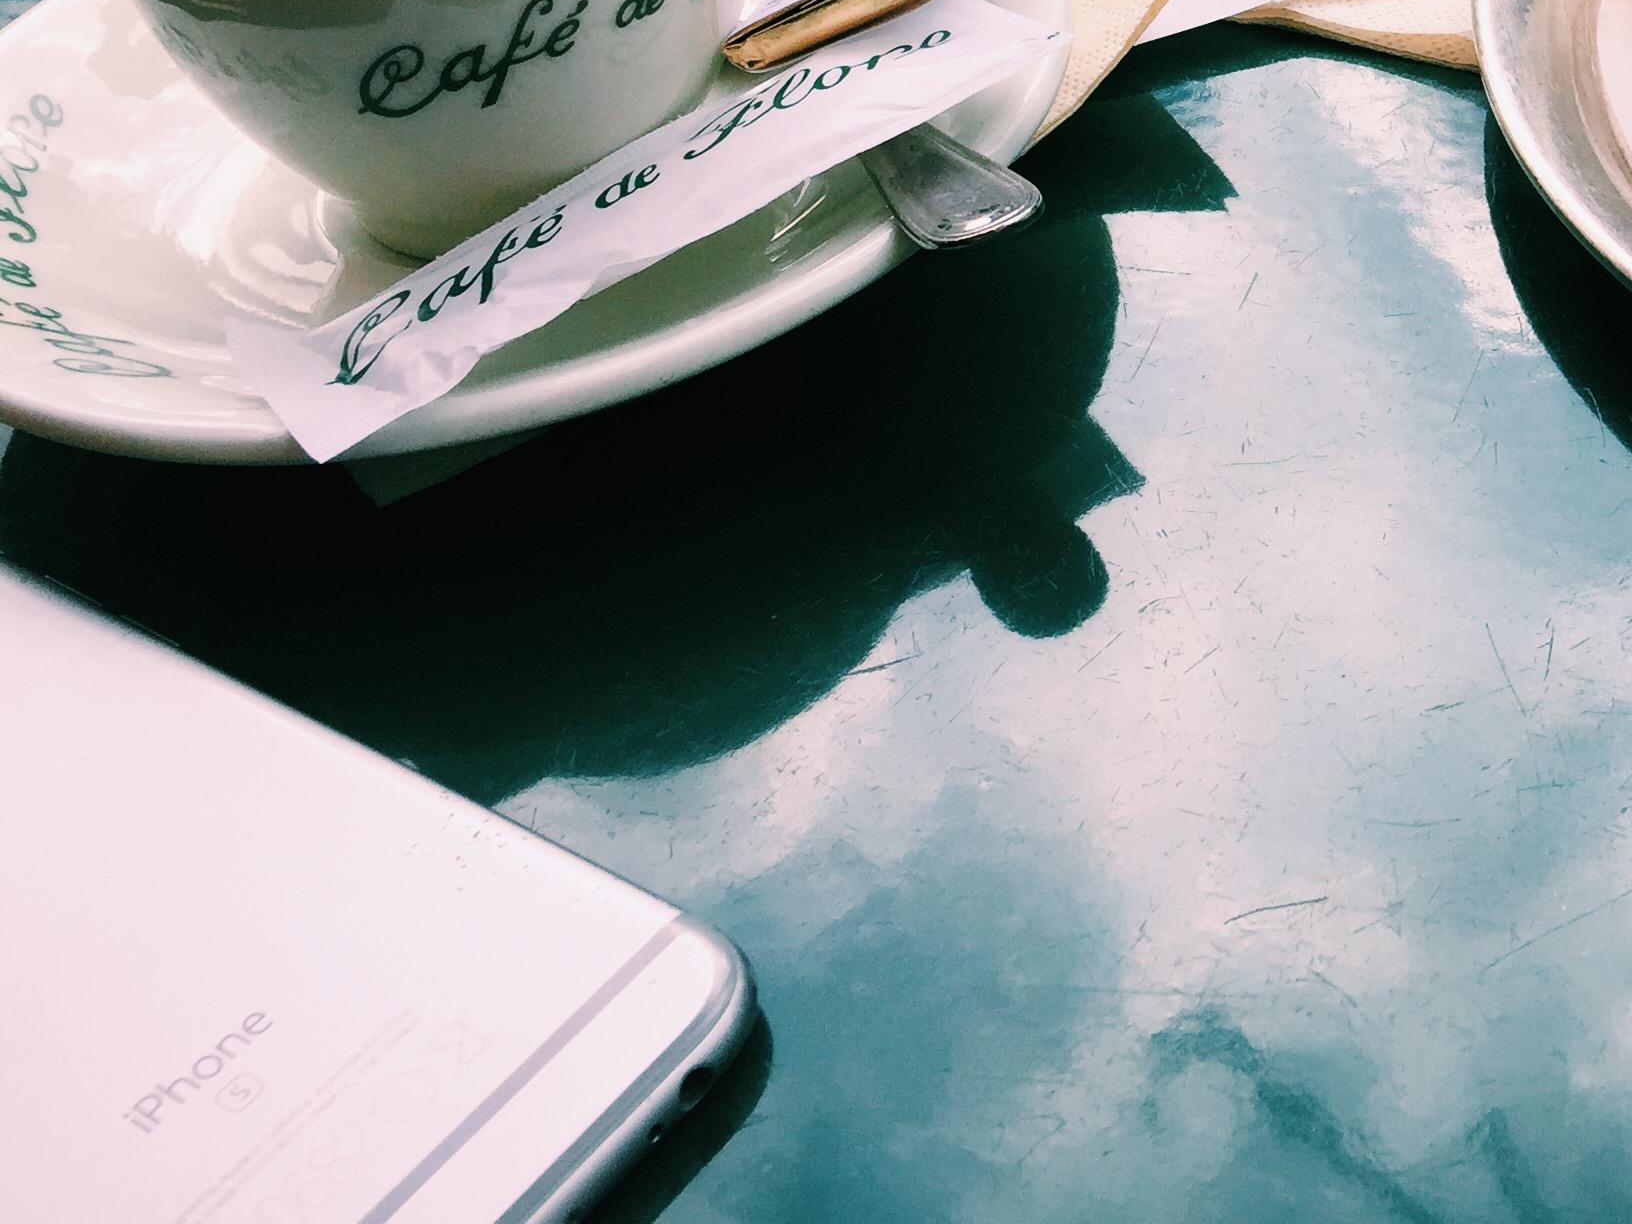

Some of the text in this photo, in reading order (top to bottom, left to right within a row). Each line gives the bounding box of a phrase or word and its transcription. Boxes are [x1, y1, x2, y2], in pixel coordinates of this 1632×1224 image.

[325, 29, 952, 385] Café de Flore
[122, 1010, 274, 1134] iPhone
